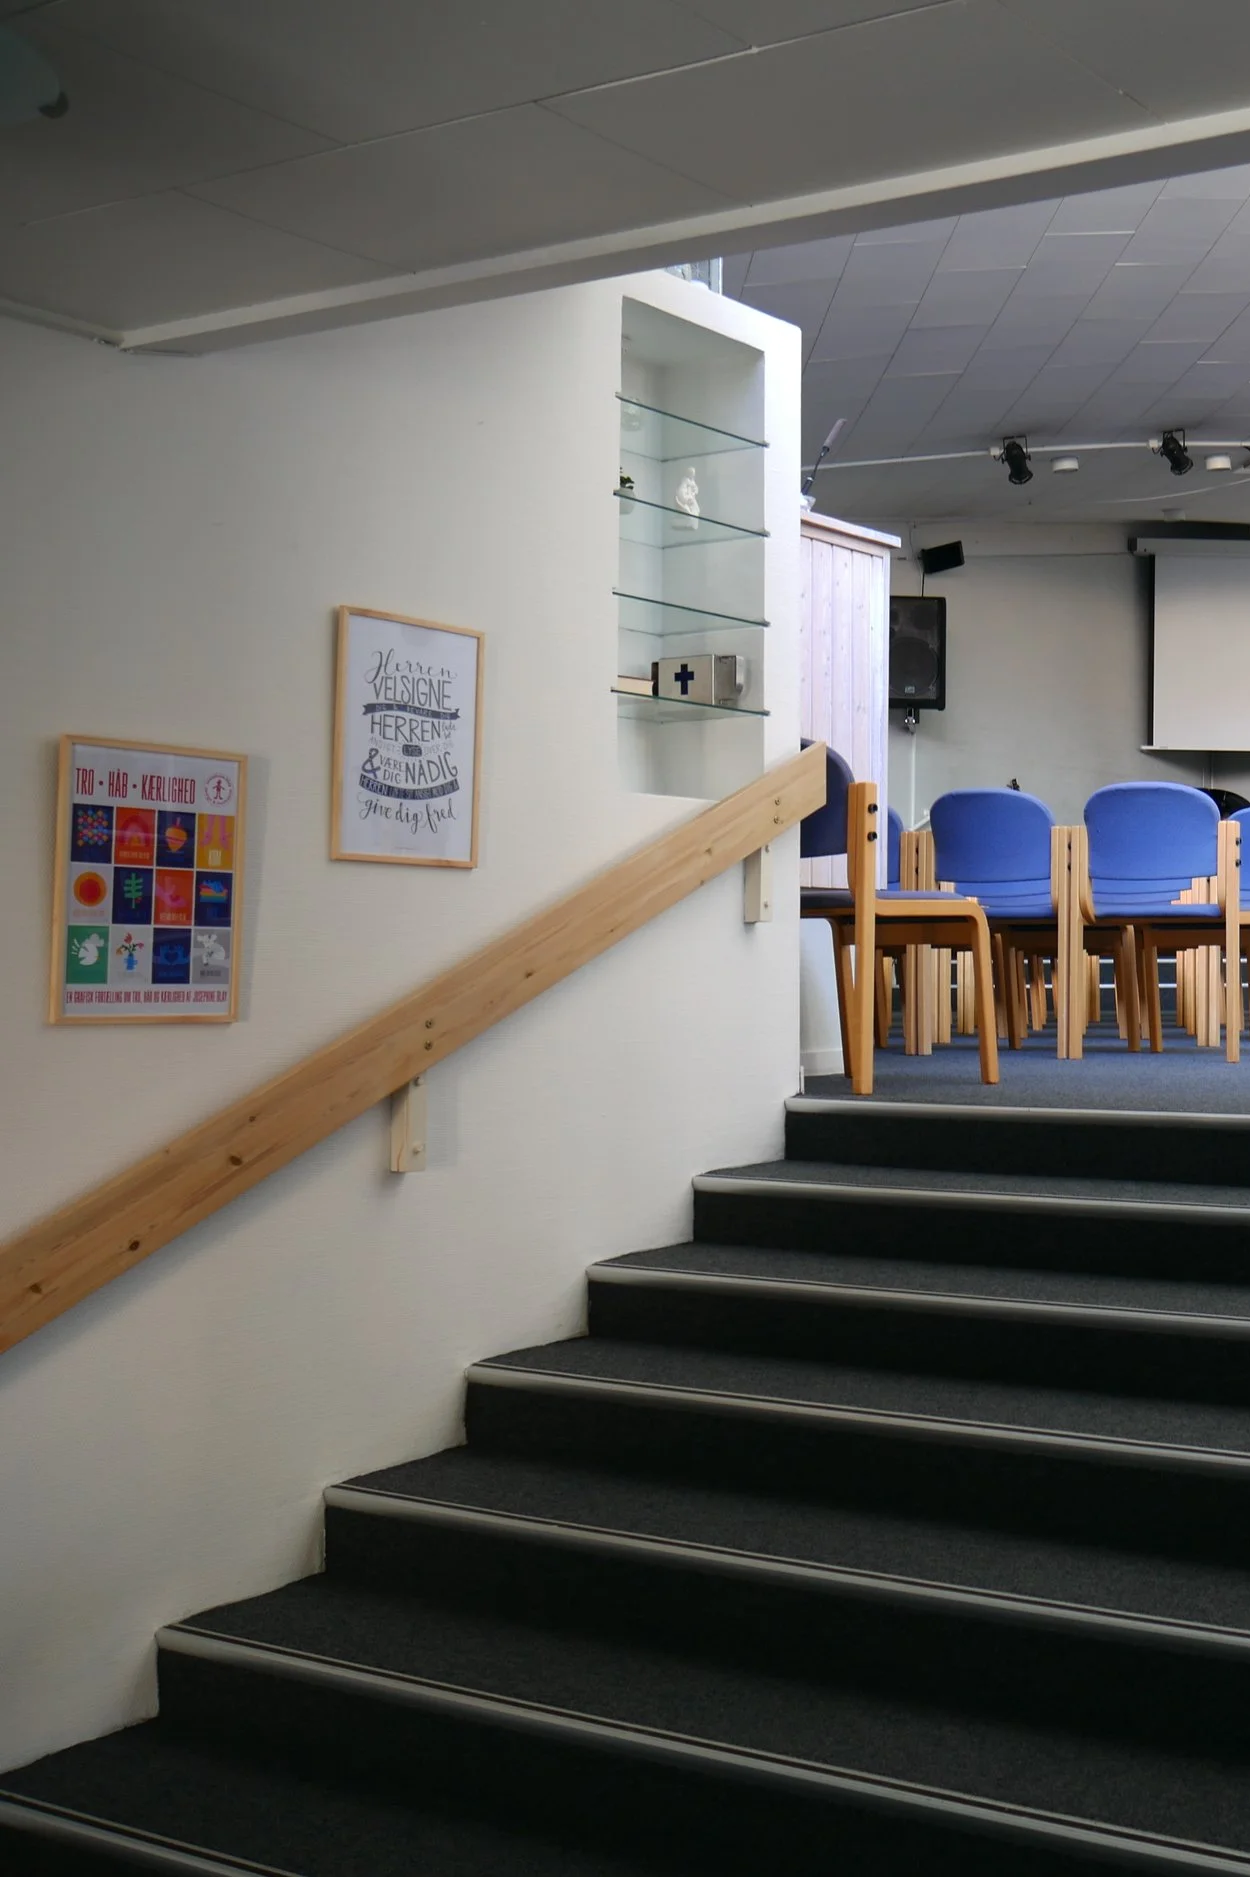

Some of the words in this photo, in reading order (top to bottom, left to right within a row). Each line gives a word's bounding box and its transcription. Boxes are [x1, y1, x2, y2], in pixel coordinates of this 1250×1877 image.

[364, 648, 457, 684] Herren
[373, 675, 452, 711] VELSIGNE
[371, 714, 441, 743] HERREN
[361, 748, 381, 779] &
[380, 754, 405, 773] VÆRE
[405, 751, 459, 785] NÅDIG
[383, 768, 402, 784] DIG
[76, 768, 94, 796] TRO
[108, 769, 128, 798] HÅB
[141, 774, 196, 805] KÆRLIGHED
[361, 774, 389, 797] HERREN
[359, 797, 391, 820] give
[395, 802, 421, 835] dig
[425, 798, 457, 834] fred
